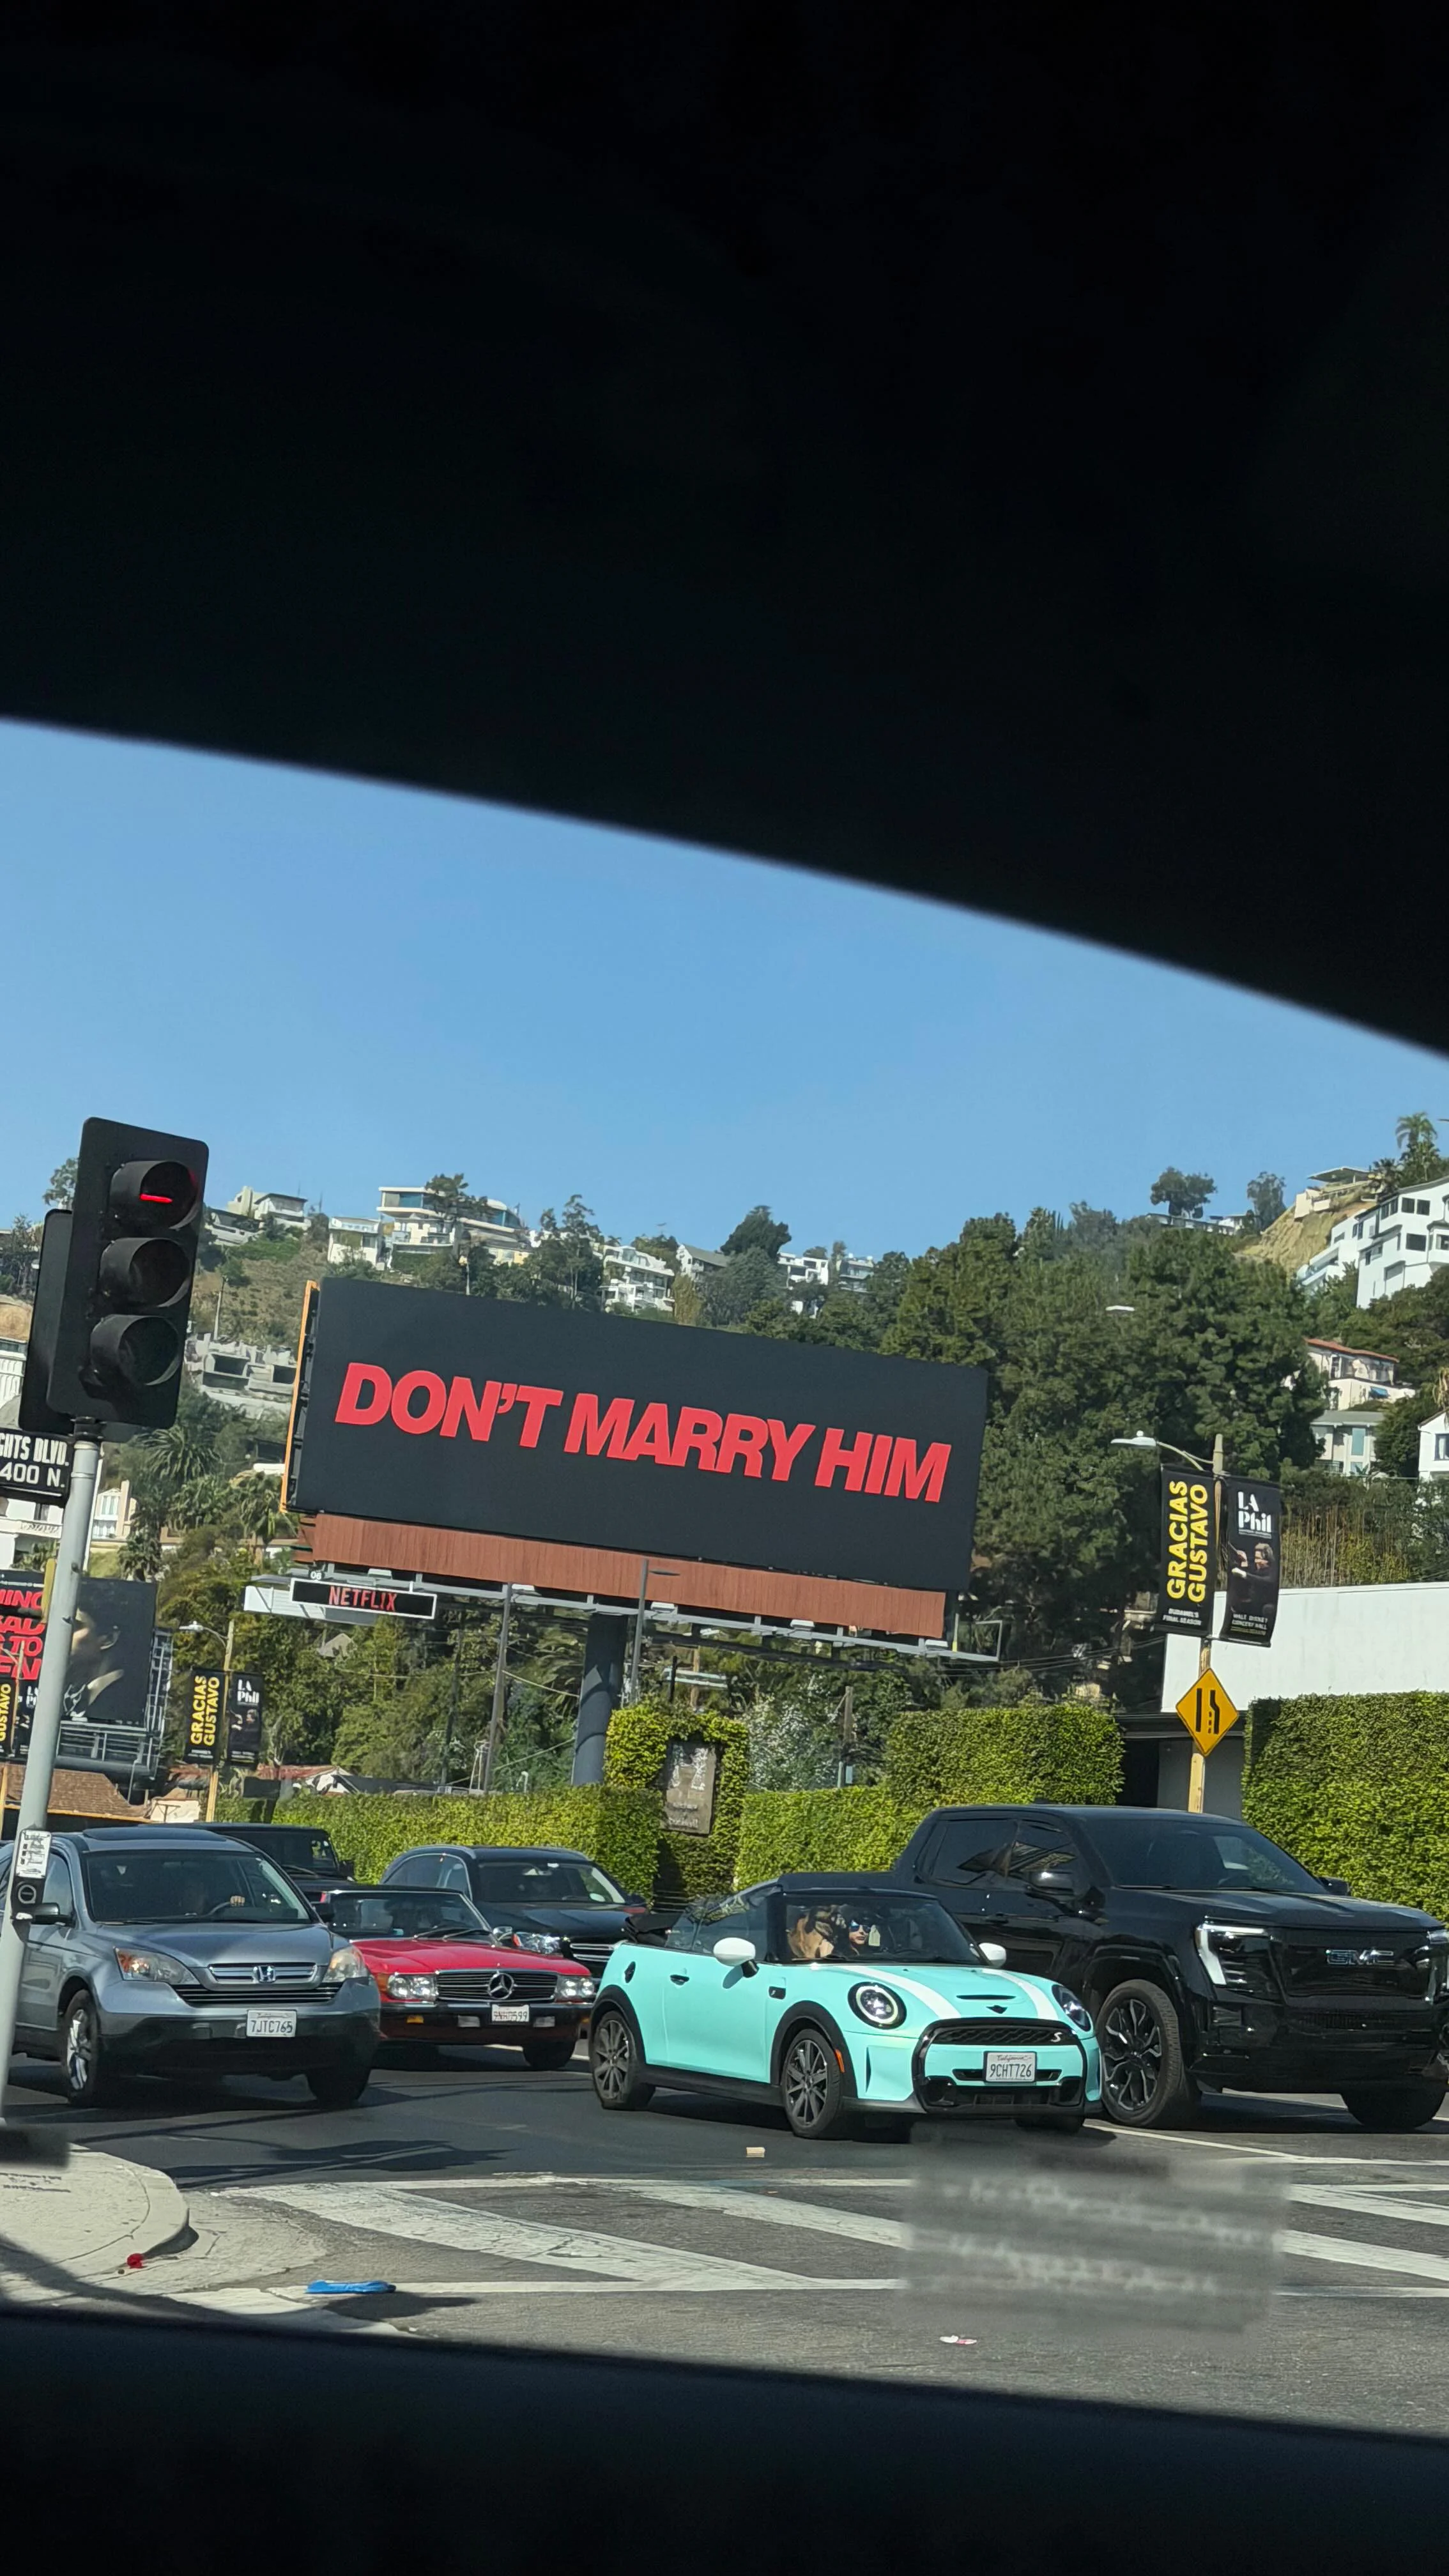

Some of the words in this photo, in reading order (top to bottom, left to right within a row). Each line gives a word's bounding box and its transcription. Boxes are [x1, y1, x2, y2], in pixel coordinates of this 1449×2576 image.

[335, 1363, 564, 1448] DON'T
[564, 1393, 816, 1482] MARRY
[815, 1427, 952, 1503] HIM
[0, 1462, 39, 1484] 400
[47, 1468, 65, 1487] N.
[1238, 1491, 1259, 1512] LA
[1238, 1510, 1271, 1533] Phil
[1167, 1480, 1188, 1599] GRACIAS
[1187, 1483, 1208, 1603] GUSTAVO
[328, 1586, 397, 1612] NETFLIX
[10, 1636, 43, 1657] TO
[191, 1675, 207, 1745] GRACIAS
[203, 1676, 220, 1747] GUSTAVO
[1326, 1949, 1395, 1965] GMC
[250, 2020, 293, 2034] 7JTC765
[1050, 2032, 1062, 2043] S
[990, 2063, 1032, 2078] 9CHT726
